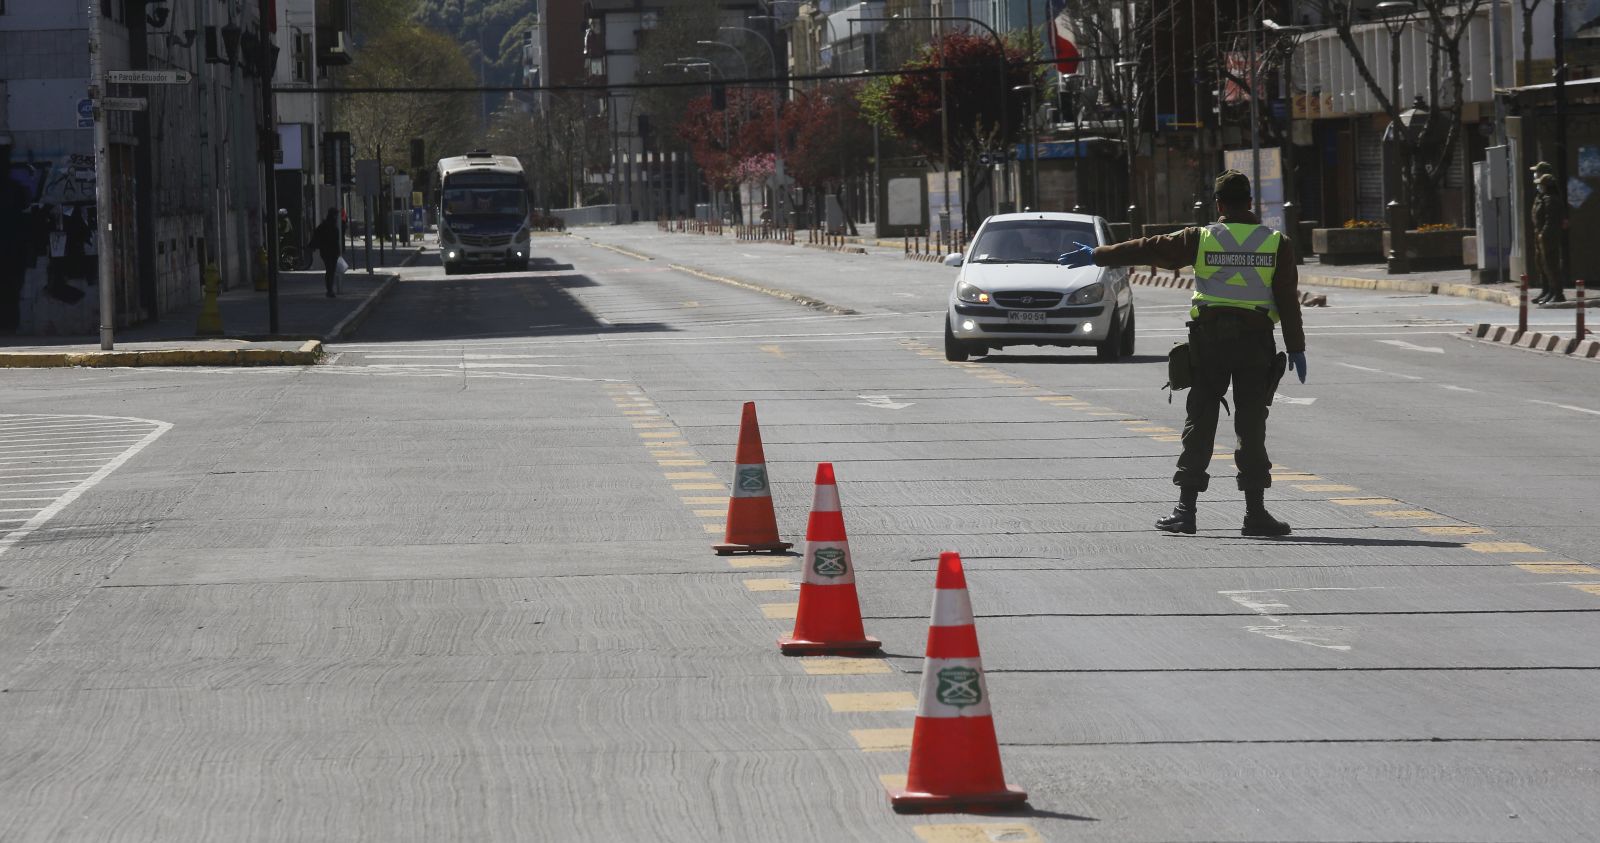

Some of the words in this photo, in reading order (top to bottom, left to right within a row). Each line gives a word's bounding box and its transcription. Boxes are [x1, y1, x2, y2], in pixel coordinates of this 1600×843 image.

[118, 73, 141, 82] Parque
[142, 73, 168, 81] Ecuador
[1207, 254, 1246, 265] CARABINEROS
[1247, 255, 1255, 265] DE
[1256, 255, 1273, 265] CHILE
